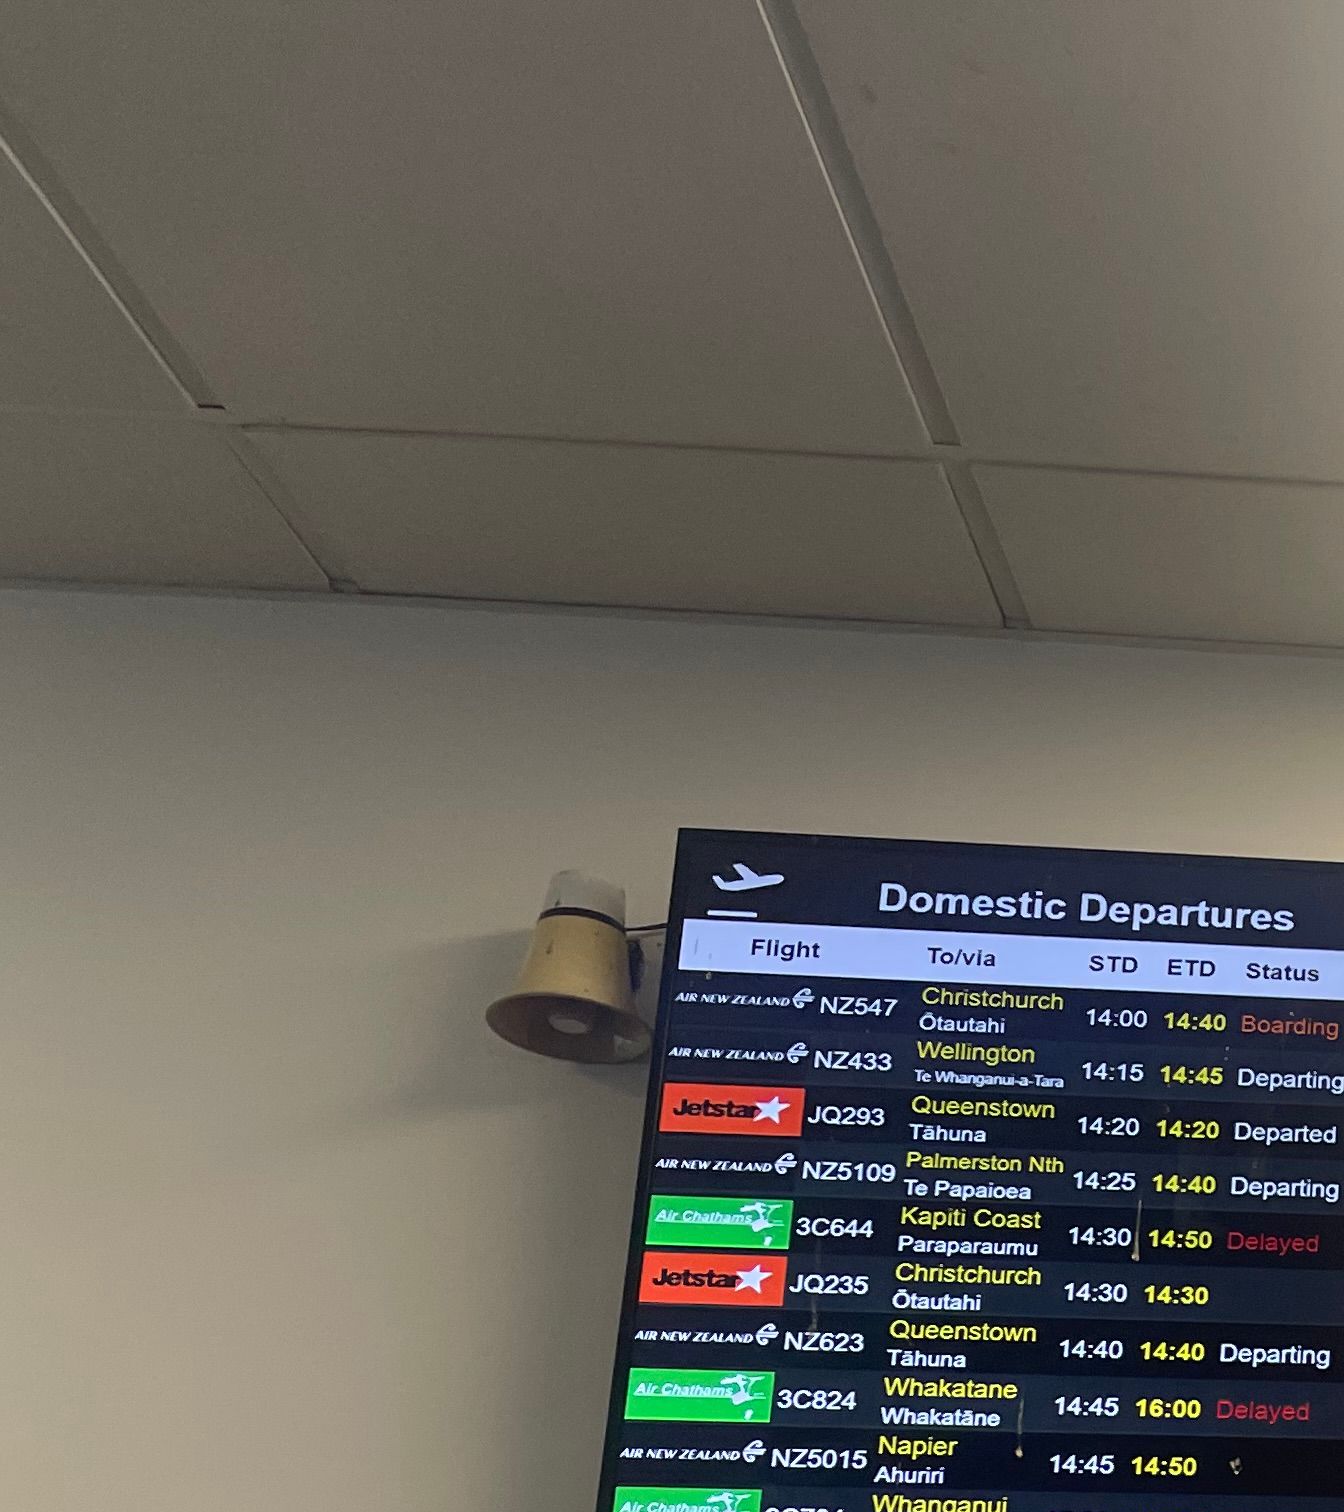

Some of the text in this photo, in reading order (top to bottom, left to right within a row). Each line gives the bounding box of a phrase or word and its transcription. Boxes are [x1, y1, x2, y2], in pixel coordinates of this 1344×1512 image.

[879, 883, 1294, 939] Domestic Departures
[752, 939, 819, 961] Flight
[928, 948, 995, 966] To/via
[1089, 956, 1137, 973] STD
[1168, 959, 1215, 976] ETD
[1247, 963, 1319, 981] Status
[675, 992, 698, 1003] AIR
[700, 994, 730, 1004] NEW
[732, 995, 791, 1007] ZEALAND
[820, 996, 899, 1017] NZ547
[922, 987, 1063, 1010] Christchurch
[1087, 1009, 1147, 1028] 14:00
[1164, 1012, 1226, 1031] 14:40
[1242, 1015, 1338, 1040] Boarding
[919, 1011, 1005, 1033] Ōtautahi
[673, 1099, 760, 1118] Jetstar
[808, 1106, 885, 1126] JQ293
[912, 1096, 1055, 1118] Queenstown
[1078, 1117, 1140, 1136] 14:20
[1156, 1120, 1219, 1138] 14:20
[1233, 1122, 1336, 1145] Departed
[908, 1123, 986, 1142] Tāhuna
[655, 1209, 679, 1222] Air
[682, 1210, 753, 1224] Chathams
[796, 1217, 874, 1238] 3C644
[901, 1207, 966, 1230] Kapiti
[974, 1209, 1042, 1229] Coast
[1069, 1227, 1131, 1246] 14:30
[1149, 1229, 1212, 1249] 14:50
[1227, 1232, 1319, 1255] Delayed
[898, 1235, 1038, 1257] Paraparaumu
